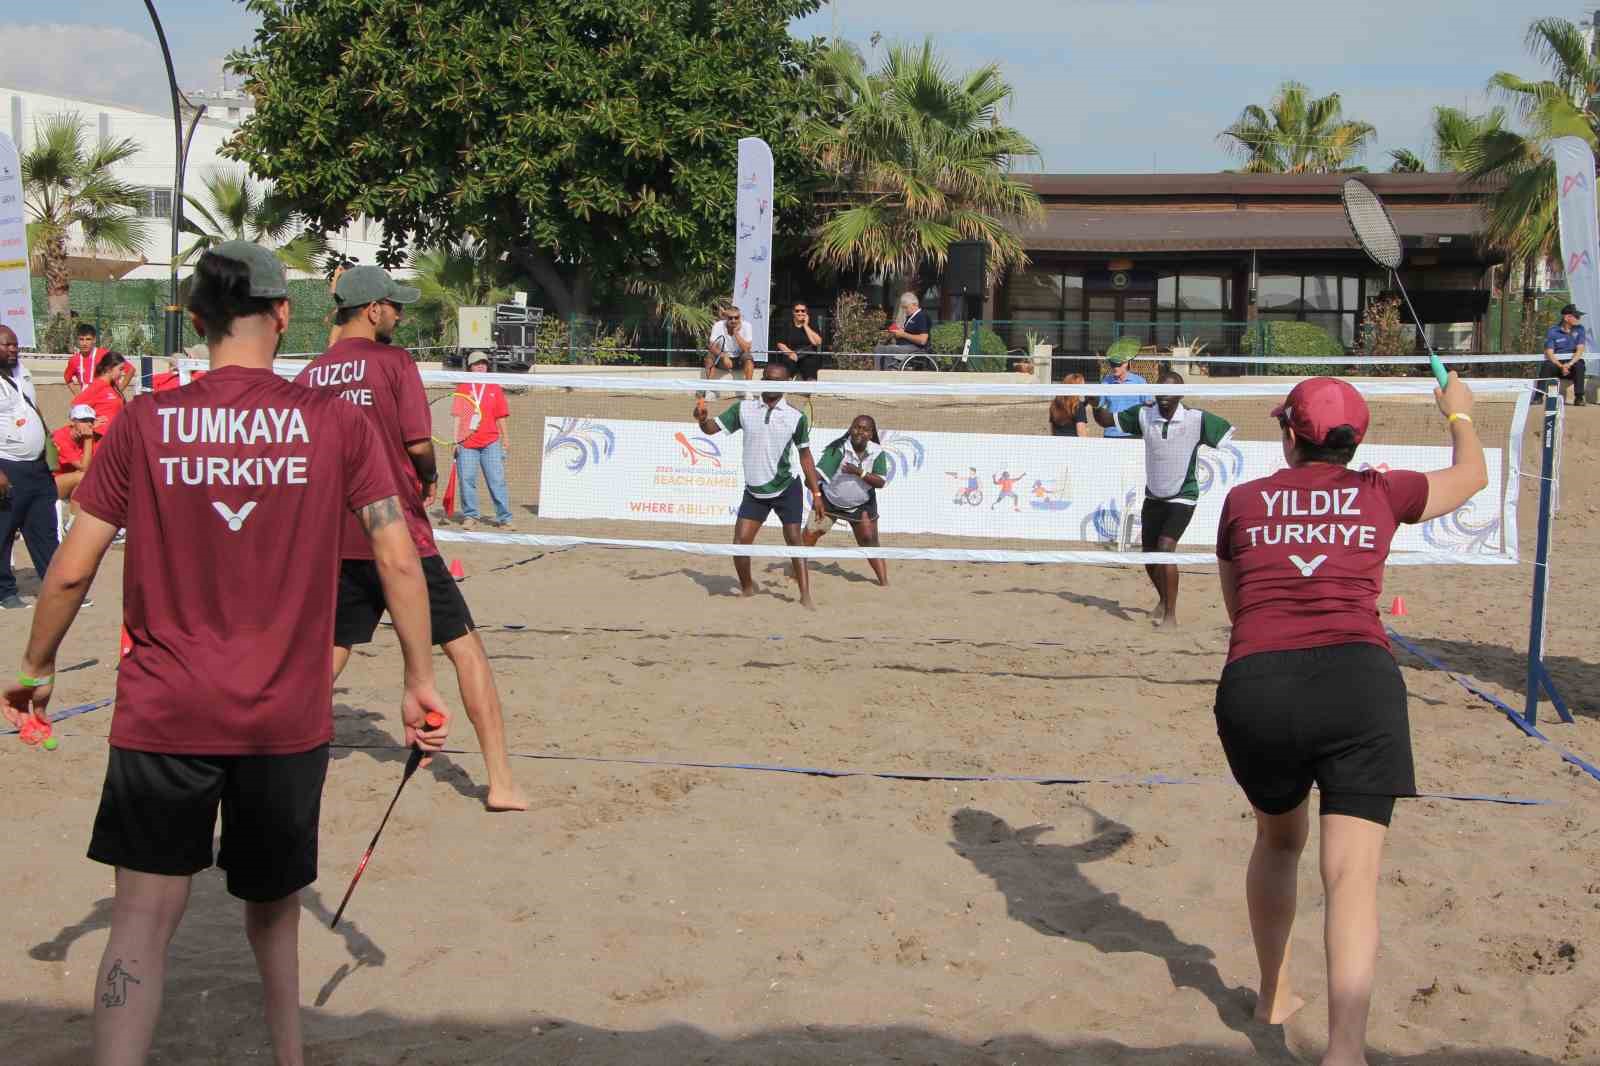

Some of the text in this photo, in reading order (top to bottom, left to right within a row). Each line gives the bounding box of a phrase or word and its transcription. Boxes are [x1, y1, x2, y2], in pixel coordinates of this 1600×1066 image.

[308, 360, 366, 388] TUZCU
[157, 407, 310, 445] TUMKAYA
[630, 502, 674, 514] WHERE
[677, 503, 725, 515] ABILITY
[1260, 487, 1361, 517] YILDIZ
